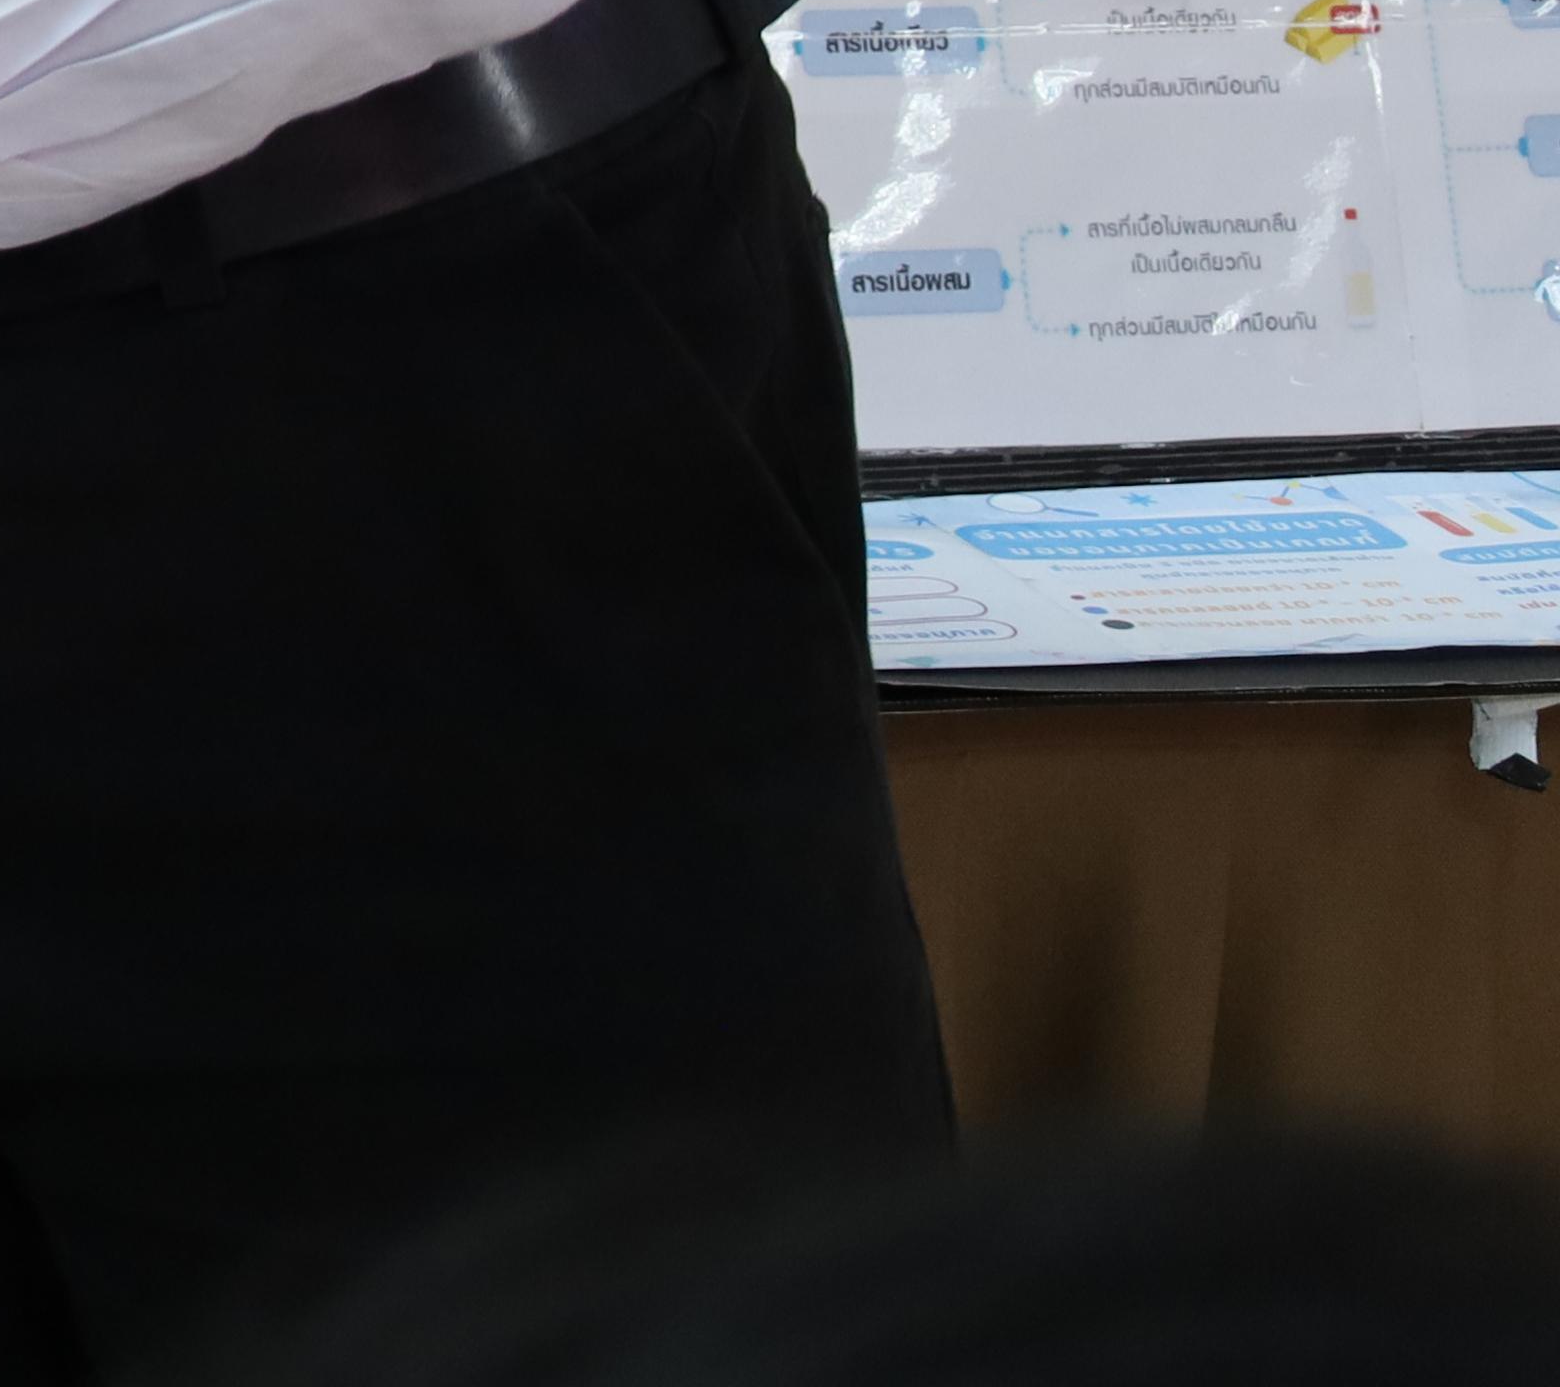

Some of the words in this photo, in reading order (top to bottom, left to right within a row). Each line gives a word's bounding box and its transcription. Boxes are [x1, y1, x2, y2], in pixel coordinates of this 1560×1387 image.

[1131, 249, 1261, 274] เป็นเนื้อเดียวกัน
[851, 263, 971, 293] สารเนื้อผสม
